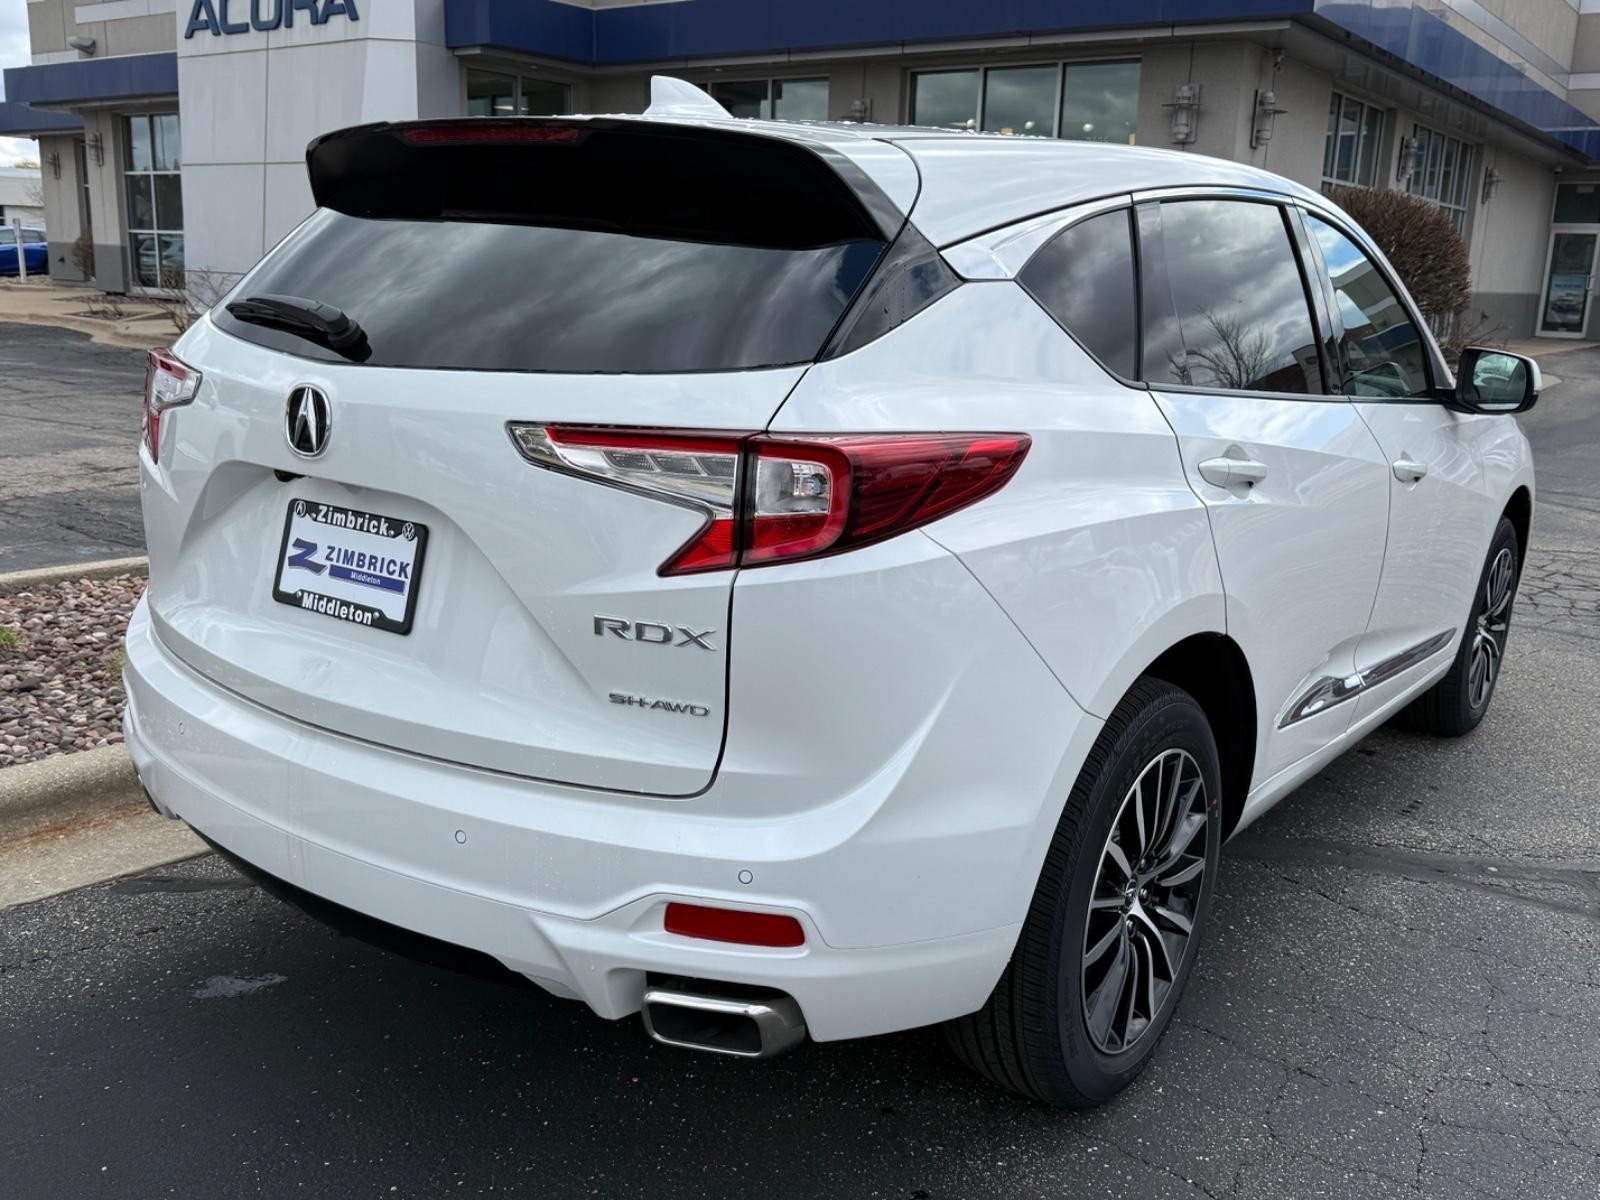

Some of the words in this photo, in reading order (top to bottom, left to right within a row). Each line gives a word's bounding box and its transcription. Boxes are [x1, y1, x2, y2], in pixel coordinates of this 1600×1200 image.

[316, 504, 389, 536] Zimbrick
[325, 545, 411, 579] ZIMBRICK
[351, 571, 381, 585] Middleton
[302, 591, 373, 625] Middleton
[593, 614, 718, 651] RDX
[609, 692, 710, 717] SH-AWD
